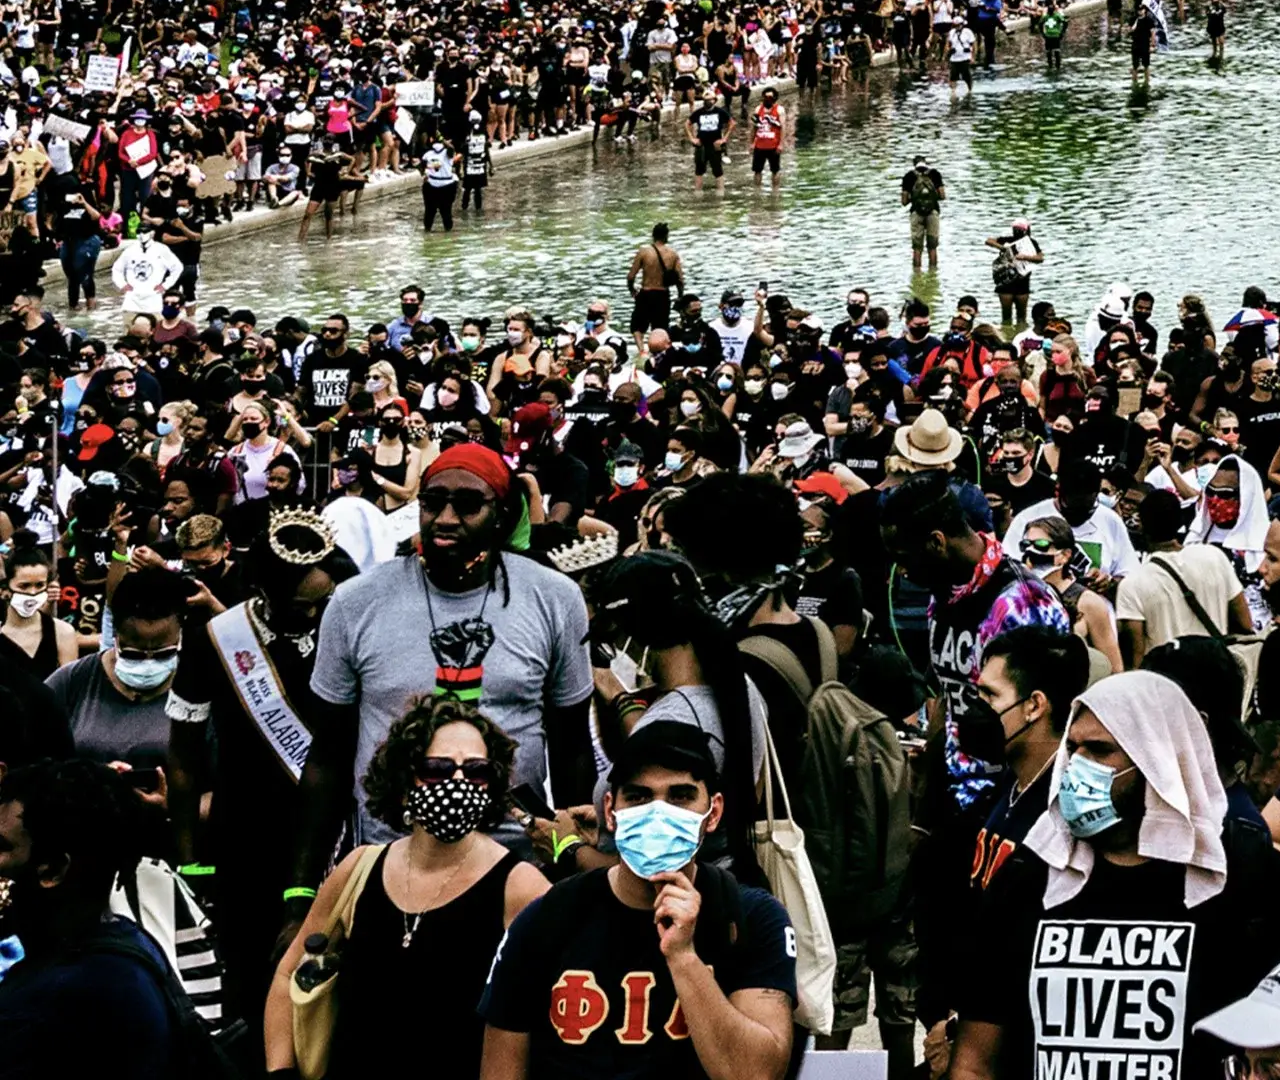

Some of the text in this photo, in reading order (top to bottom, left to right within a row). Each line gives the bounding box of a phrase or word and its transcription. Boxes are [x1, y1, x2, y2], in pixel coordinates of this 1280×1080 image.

[312, 369, 350, 382] BLACK
[312, 382, 349, 395] LIVES
[245, 679, 263, 708] BLACK
[258, 677, 272, 698] MISS
[1038, 926, 1186, 967] BLACK
[1036, 977, 1177, 1042] LIVES
[1037, 1050, 1175, 1080] MATTER
